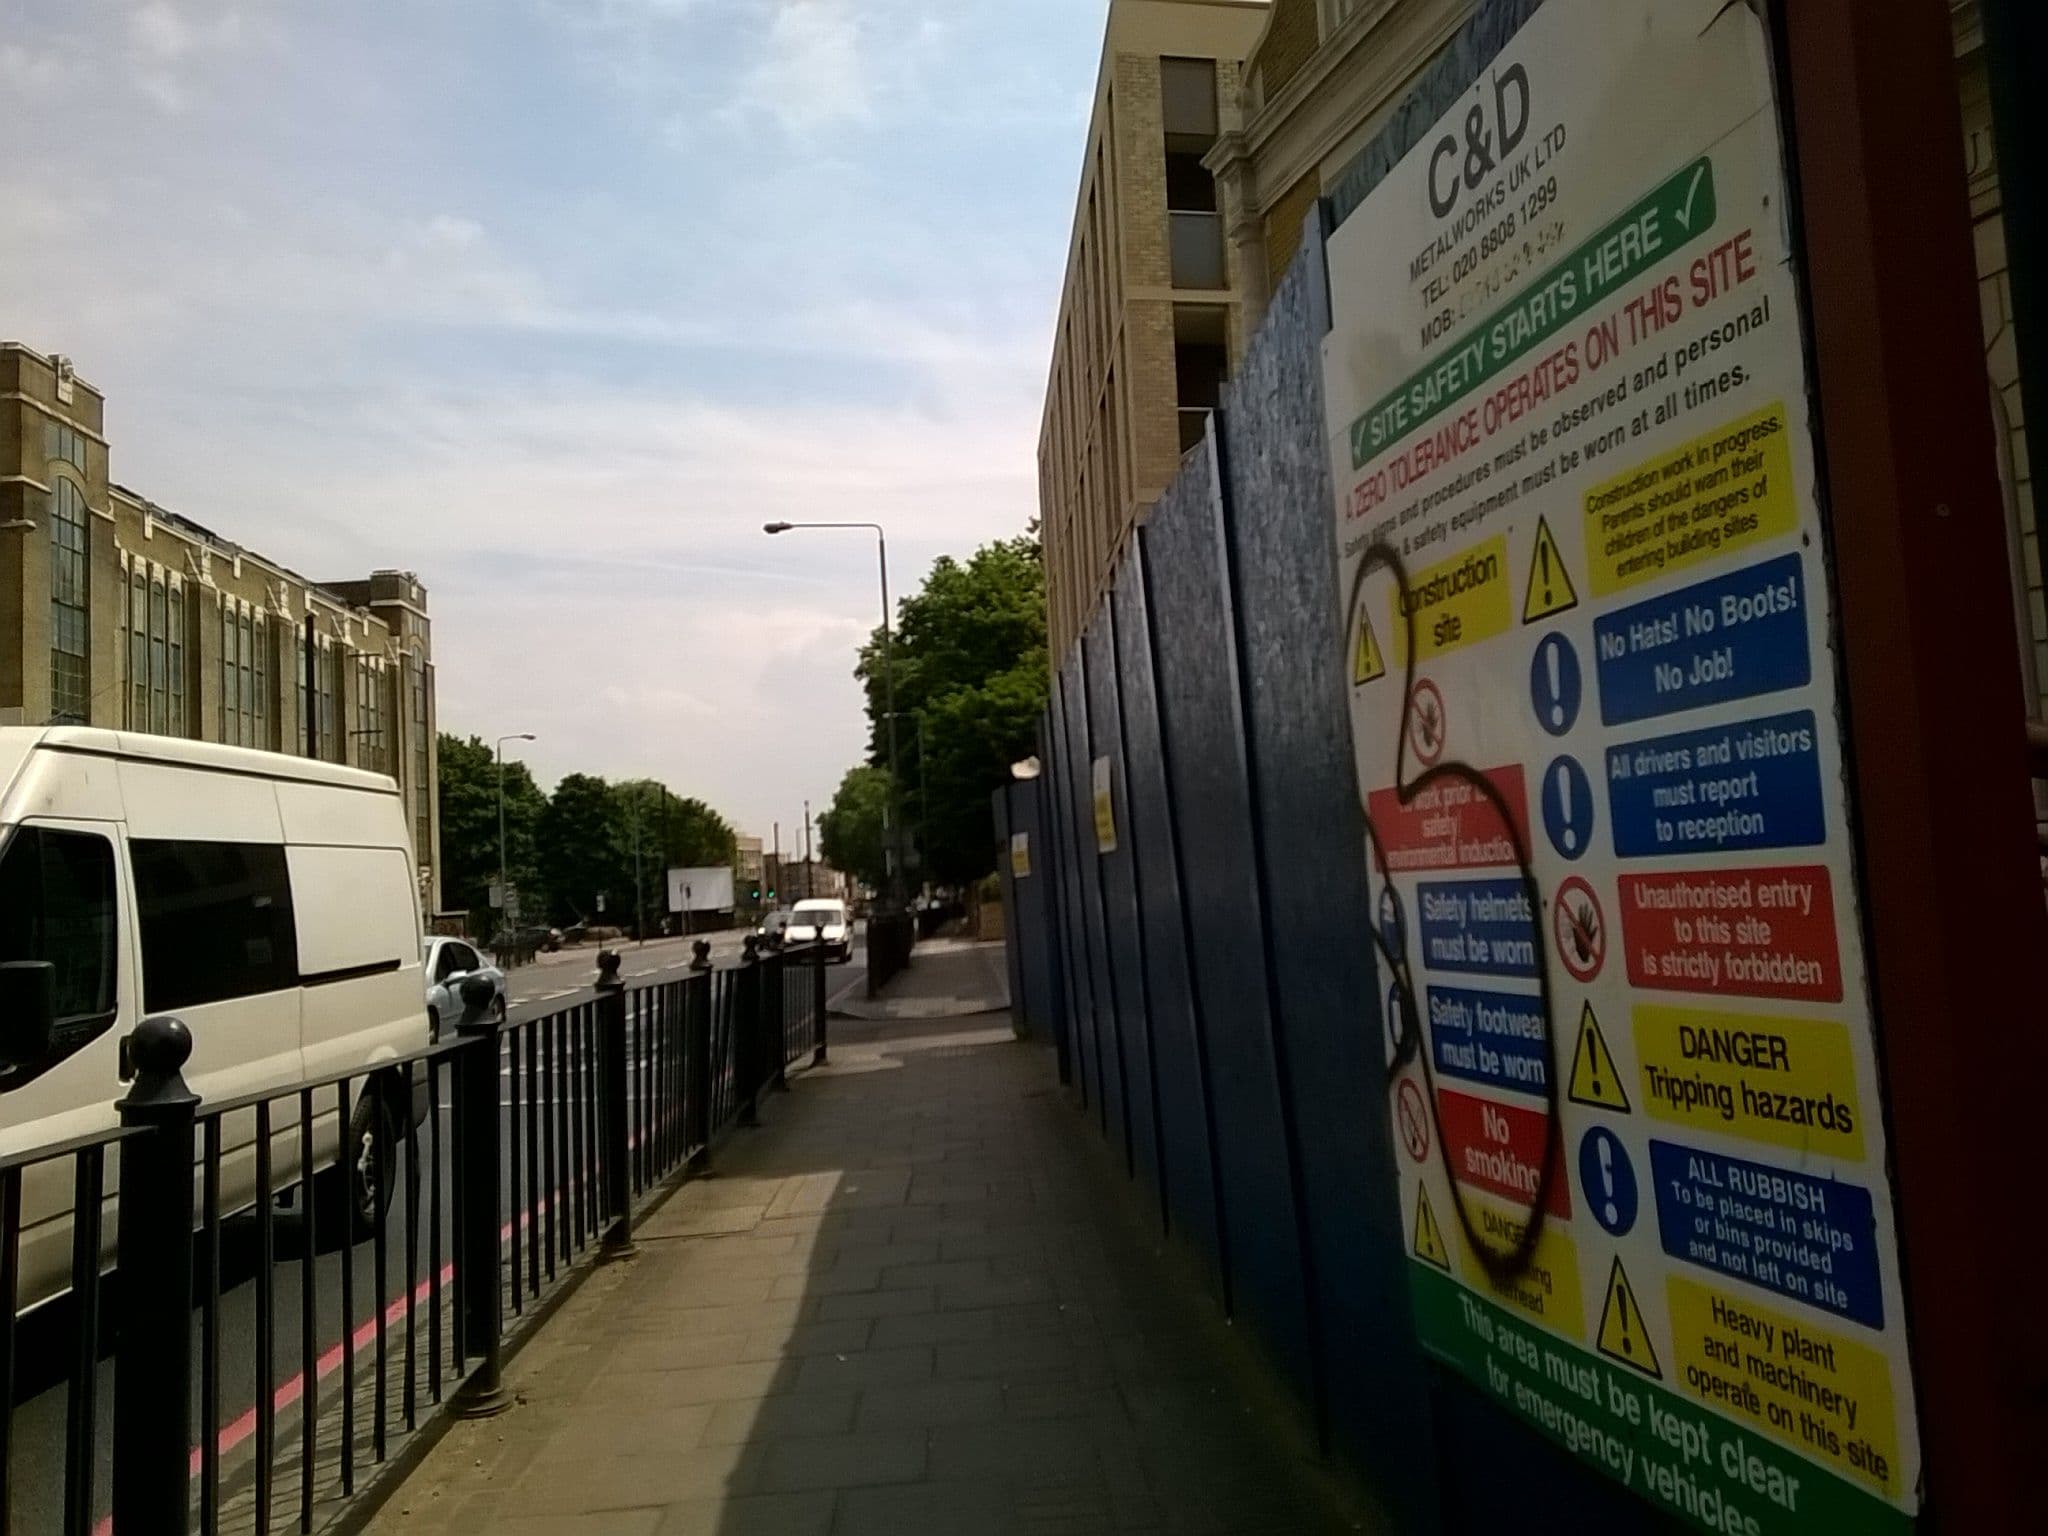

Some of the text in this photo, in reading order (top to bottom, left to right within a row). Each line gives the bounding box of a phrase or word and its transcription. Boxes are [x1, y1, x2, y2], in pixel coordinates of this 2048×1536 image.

[1428, 62, 1530, 219] C&D
[1409, 180, 1505, 281] METALWORKS
[1509, 154, 1532, 192] UK
[1535, 123, 1566, 170] LTD
[1422, 275, 1449, 308] TEL:
[1453, 247, 1478, 283] 020
[1481, 213, 1515, 260] 8808
[1521, 176, 1558, 224] 1299
[1371, 395, 1408, 447] SITE
[1411, 336, 1487, 416] SAFETY
[1491, 270, 1577, 359] STARTS
[1584, 207, 1663, 296] HERE
[1421, 308, 1456, 348] MOB:
[1355, 471, 1387, 518] ZERO
[1389, 408, 1481, 492] TOLERANCE
[1484, 341, 1580, 436] OPERATES
[1585, 313, 1619, 371] ON
[1624, 275, 1682, 345] THIS
[1690, 228, 1756, 308] SITE
[1422, 461, 1491, 516] procedures
[1494, 438, 1527, 471] must
[1530, 428, 1548, 452] be
[1552, 376, 1627, 437] observed
[1633, 352, 1668, 393] and
[1675, 295, 1770, 376] personal
[1452, 481, 1519, 531] equipment
[1522, 461, 1556, 494] must
[1559, 450, 1580, 476] be
[1584, 425, 1625, 460] worn
[1631, 408, 1649, 437] at
[1655, 392, 1678, 425] all
[1685, 364, 1749, 410] times.
[1587, 416, 1784, 514] Construction work in progress.
[1602, 448, 1764, 533] Parents should warn their
[1605, 475, 1767, 557] children of the dangers of
[1617, 512, 1759, 577] entering building sites
[1434, 613, 1462, 647] site
[1601, 575, 1798, 661] No Hats! No Boots!
[1654, 646, 1735, 693] No Job!
[1611, 727, 1813, 780] All drivers and visitors
[1653, 769, 1760, 808] must report
[1655, 808, 1766, 845] to reception
[1423, 891, 1534, 929] Safety helmets
[1633, 879, 1813, 916] Unauthorised entry
[1673, 916, 1772, 945] to this site
[1430, 933, 1535, 966] must be worn
[1662, 949, 1720, 986] strictly
[1725, 951, 1824, 985] forbidden
[1430, 995, 1473, 1038] Safety
[1680, 1025, 1791, 1072] DANGER
[1440, 1041, 1546, 1085] must be worn
[1482, 1103, 1510, 1144] No
[1645, 1064, 1853, 1133] Tripping hazards
[1671, 1180, 1854, 1253] To be placed in skips
[1688, 1156, 1826, 1215] ALL RUBBISH
[1689, 1240, 1849, 1310] and not left on site
[1695, 1217, 1833, 1275] or bins provided
[1711, 1296, 1836, 1373] Heavy plant
[1457, 1291, 1801, 1512] This area must be kept clear
[1704, 1336, 1858, 1430] and machinery
[1486, 1352, 1510, 1398] for
[1515, 1380, 1634, 1486] emergency
[1687, 1365, 1889, 1481] operate on this site
